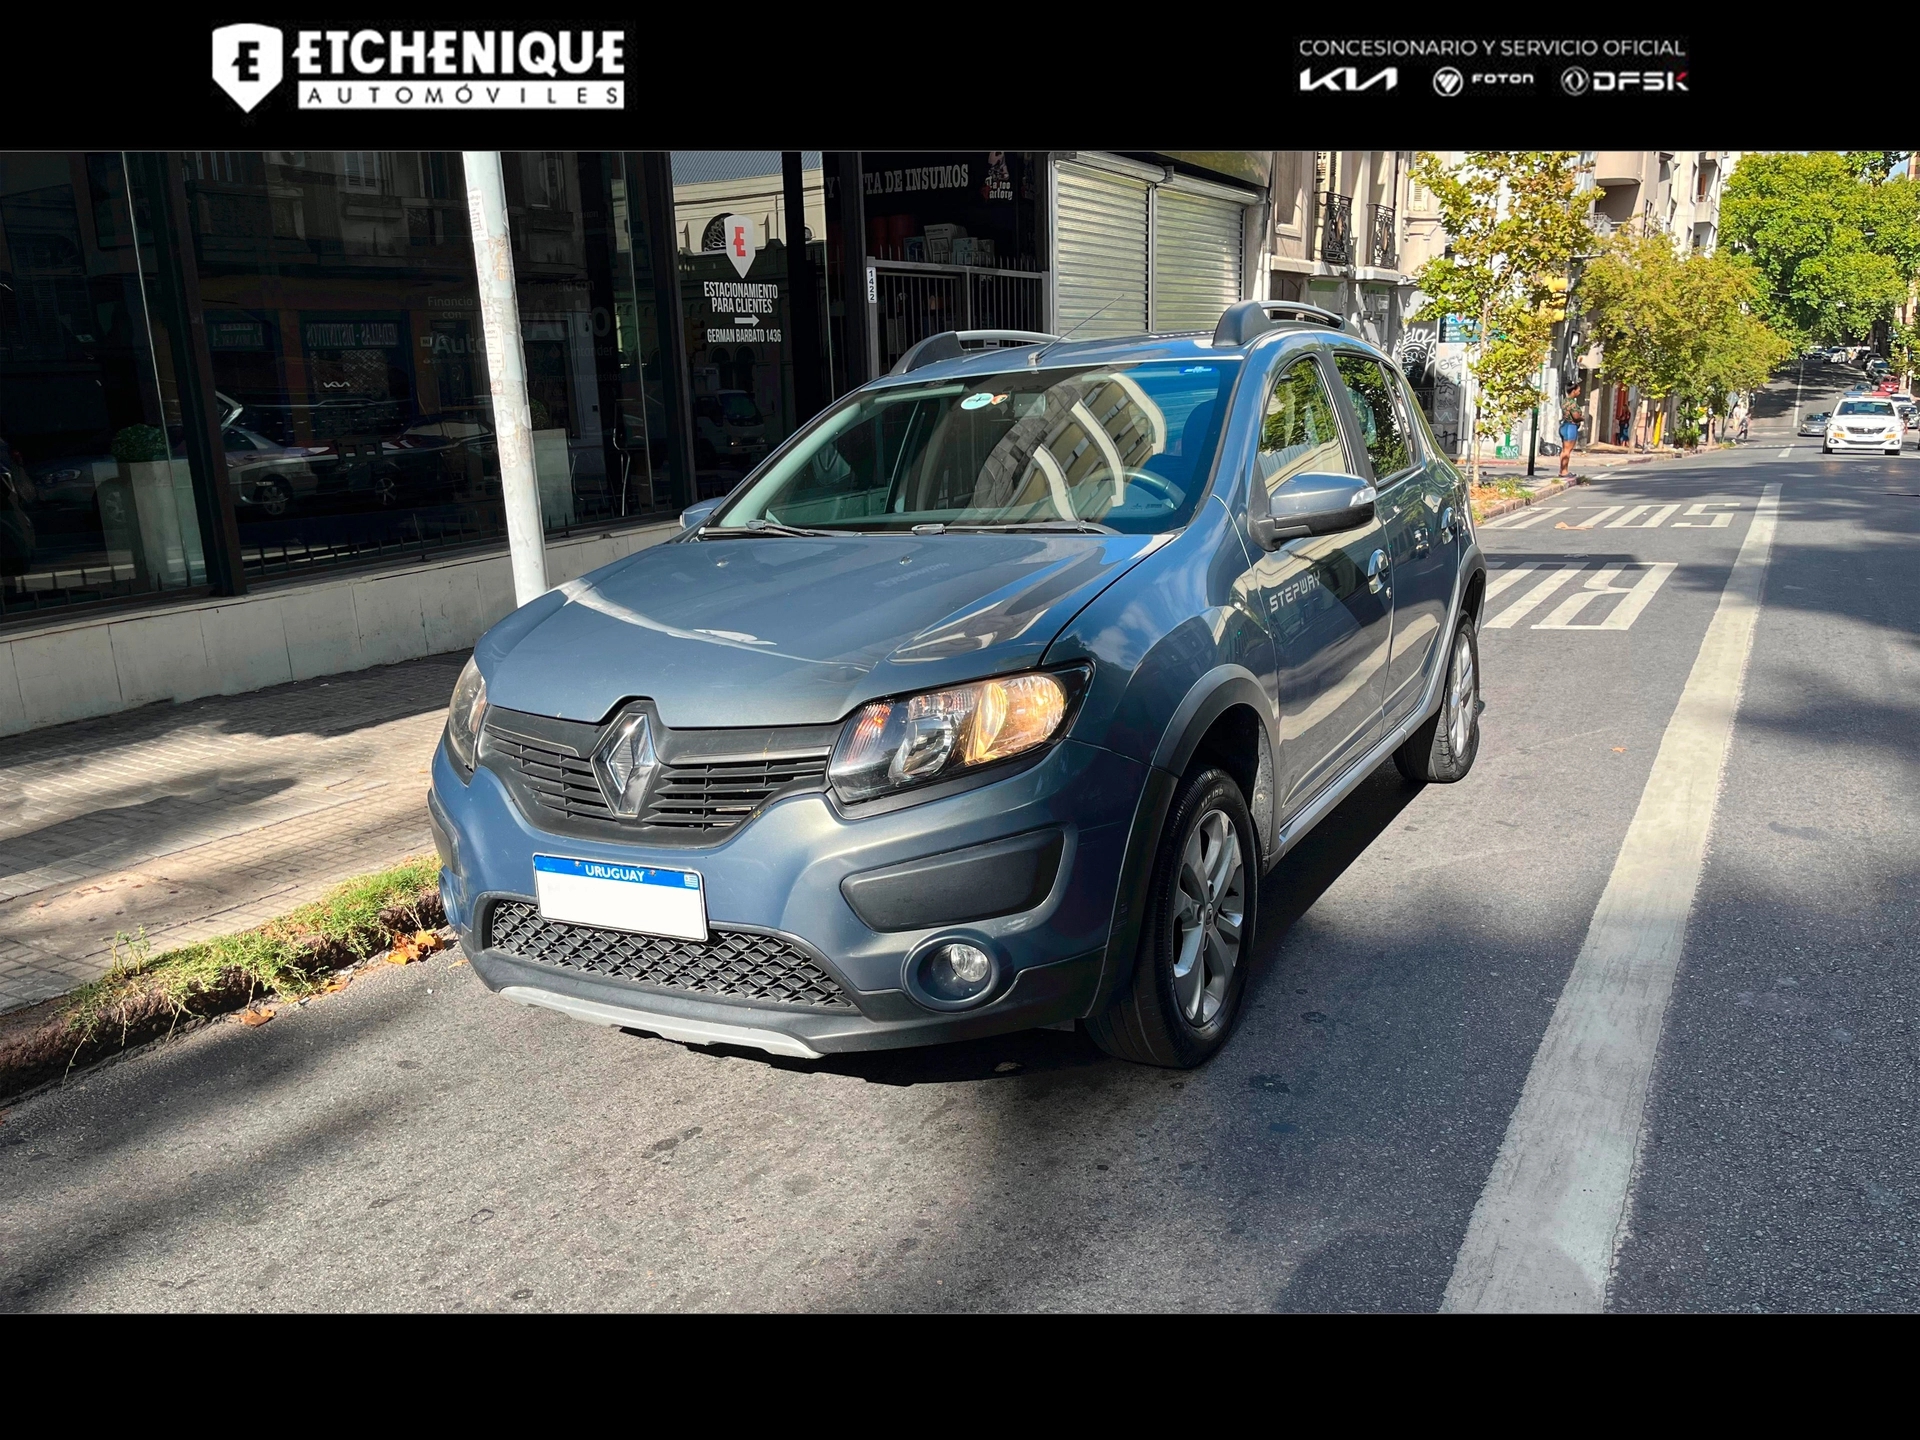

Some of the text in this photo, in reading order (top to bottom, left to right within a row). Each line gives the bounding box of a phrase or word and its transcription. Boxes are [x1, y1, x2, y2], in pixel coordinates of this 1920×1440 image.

[885, 169, 903, 194] DE
[904, 163, 969, 191] INSUMOS
[703, 281, 778, 299] ESTACIONAMIENTO
[868, 270, 876, 301] 1422
[712, 298, 773, 314] PARA CLIENTES
[707, 329, 782, 343] GERMAN BARBATO 1436
[1269, 570, 1321, 614] STEPWAY
[585, 864, 645, 882] URUGUAY
